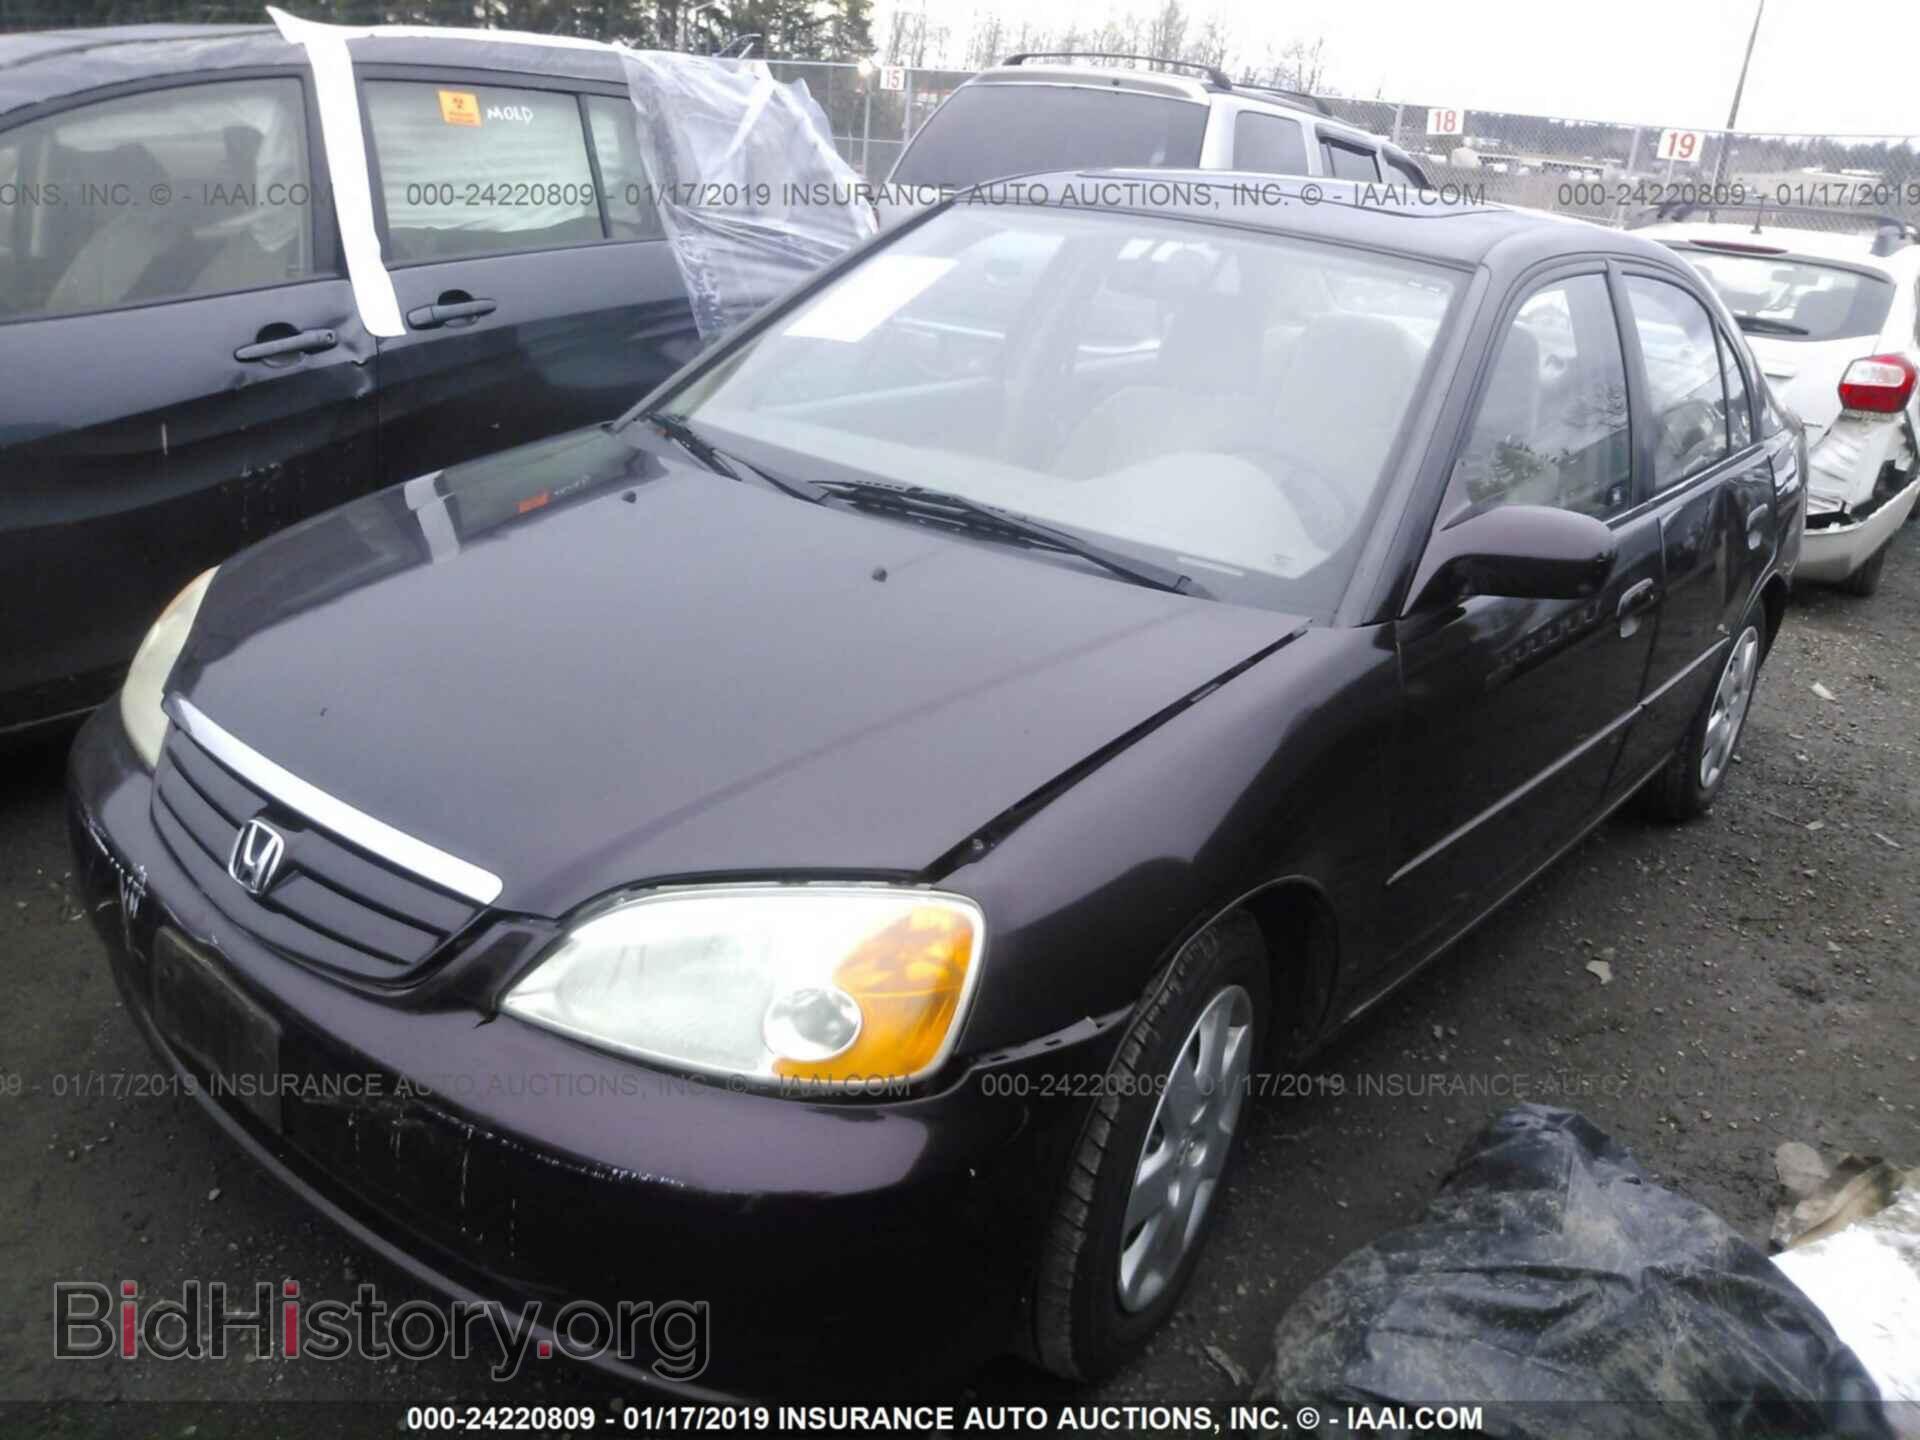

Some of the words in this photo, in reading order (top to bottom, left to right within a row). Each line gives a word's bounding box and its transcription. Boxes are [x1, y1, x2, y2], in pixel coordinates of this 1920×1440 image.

[887, 69, 900, 89] 15
[486, 105, 534, 126] MOLD
[1433, 110, 1457, 133] 18
[1667, 131, 1697, 159] 19
